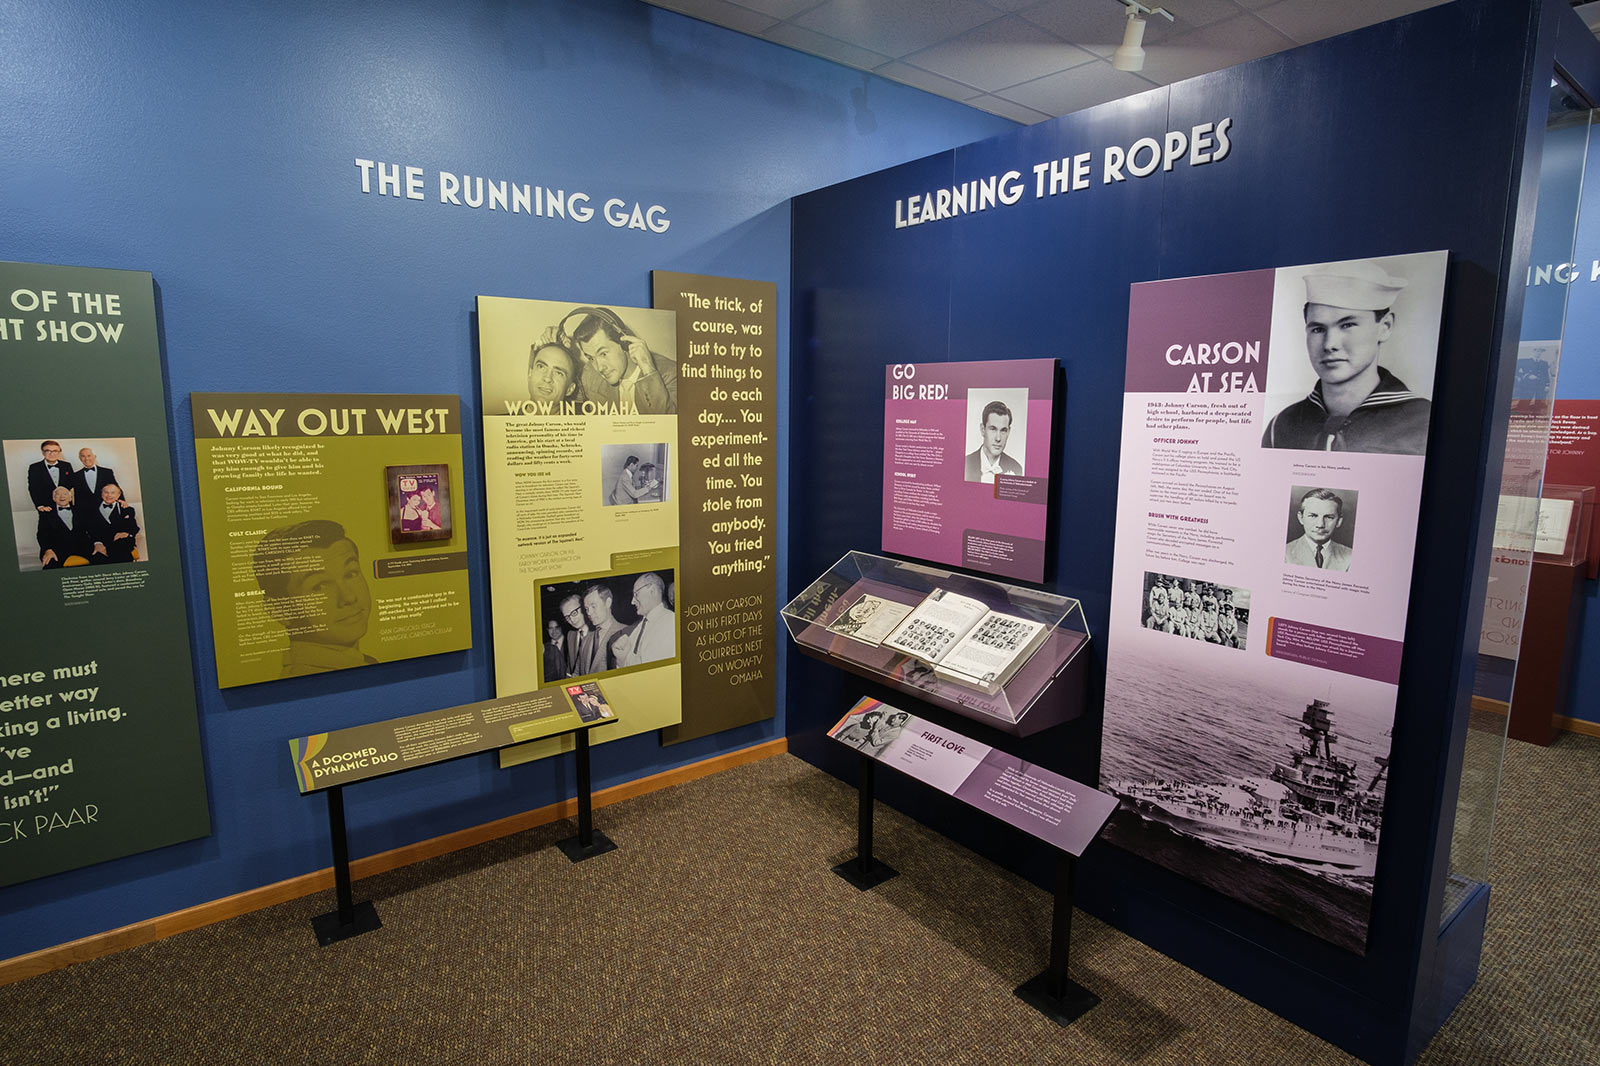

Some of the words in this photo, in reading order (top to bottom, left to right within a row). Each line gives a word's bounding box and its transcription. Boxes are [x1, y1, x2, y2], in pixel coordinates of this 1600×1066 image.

[895, 170, 1025, 229] LEARNING
[1033, 152, 1091, 198] THE
[1103, 117, 1233, 184] ROPES
[355, 158, 424, 200] THE
[439, 171, 594, 223] RUNNING
[603, 198, 670, 234] GAG
[11, 289, 57, 312] OF
[68, 292, 121, 315] THE
[715, 297, 745, 313] trick,
[750, 299, 762, 313] of
[36, 320, 124, 343] SHOW
[693, 320, 737, 335] course,
[742, 324, 762, 335] was
[689, 341, 710, 358] just
[714, 342, 727, 356] to
[731, 344, 746, 360] try
[750, 344, 762, 357] to
[1166, 341, 1260, 365] CARSON
[682, 363, 706, 378] find
[711, 365, 746, 382] things
[750, 366, 762, 379] to
[893, 364, 915, 379] GO
[1186, 372, 1212, 392] AT
[1219, 372, 1258, 392] SEA
[711, 387, 727, 401] do
[732, 388, 762, 400] each
[892, 384, 915, 400] BIG
[919, 385, 948, 400] RED!
[504, 401, 553, 416] WOW
[559, 401, 575, 415] IN
[582, 401, 639, 415] OMAHA
[741, 409, 762, 422] You
[207, 408, 285, 437] WAY
[296, 408, 367, 436] OUT
[376, 408, 449, 434] WEST
[692, 432, 768, 448] experiment-
[703, 454, 720, 467] ed
[724, 453, 739, 467] all
[743, 452, 762, 465] the
[706, 476, 736, 490] time.
[741, 474, 762, 487] You
[703, 498, 732, 512] stole
[736, 496, 762, 509] from
[712, 516, 766, 534] anybody.
[1180, 515, 1208, 524] GREATNESS
[708, 541, 731, 554] You
[735, 536, 762, 551] tried
[726, 595, 762, 610] CARSON
[687, 618, 703, 632] ON
[706, 617, 718, 629] HIS
[721, 613, 740, 626] FIRST
[743, 609, 762, 624] DAYS
[696, 633, 706, 647] AS
[709, 630, 731, 644] HOST
[733, 628, 746, 640] OF
[748, 624, 762, 636] THE
[745, 640, 762, 652] NEST
[53, 661, 98, 680] must
[708, 662, 723, 676] ON
[726, 655, 763, 672] WOW-TV
[730, 670, 762, 686] OMAHA
[59, 687, 99, 702] way
[0, 720, 39, 738] ing
[46, 717, 60, 729] a
[67, 707, 127, 726] living.
[921, 731, 942, 744] FIRST
[941, 740, 965, 754] LOVE
[311, 757, 320, 768] A
[322, 747, 377, 766] DOOMED
[314, 760, 370, 778] DYNAMIC
[372, 753, 398, 766] DUO
[35, 804, 98, 835] PAAR
